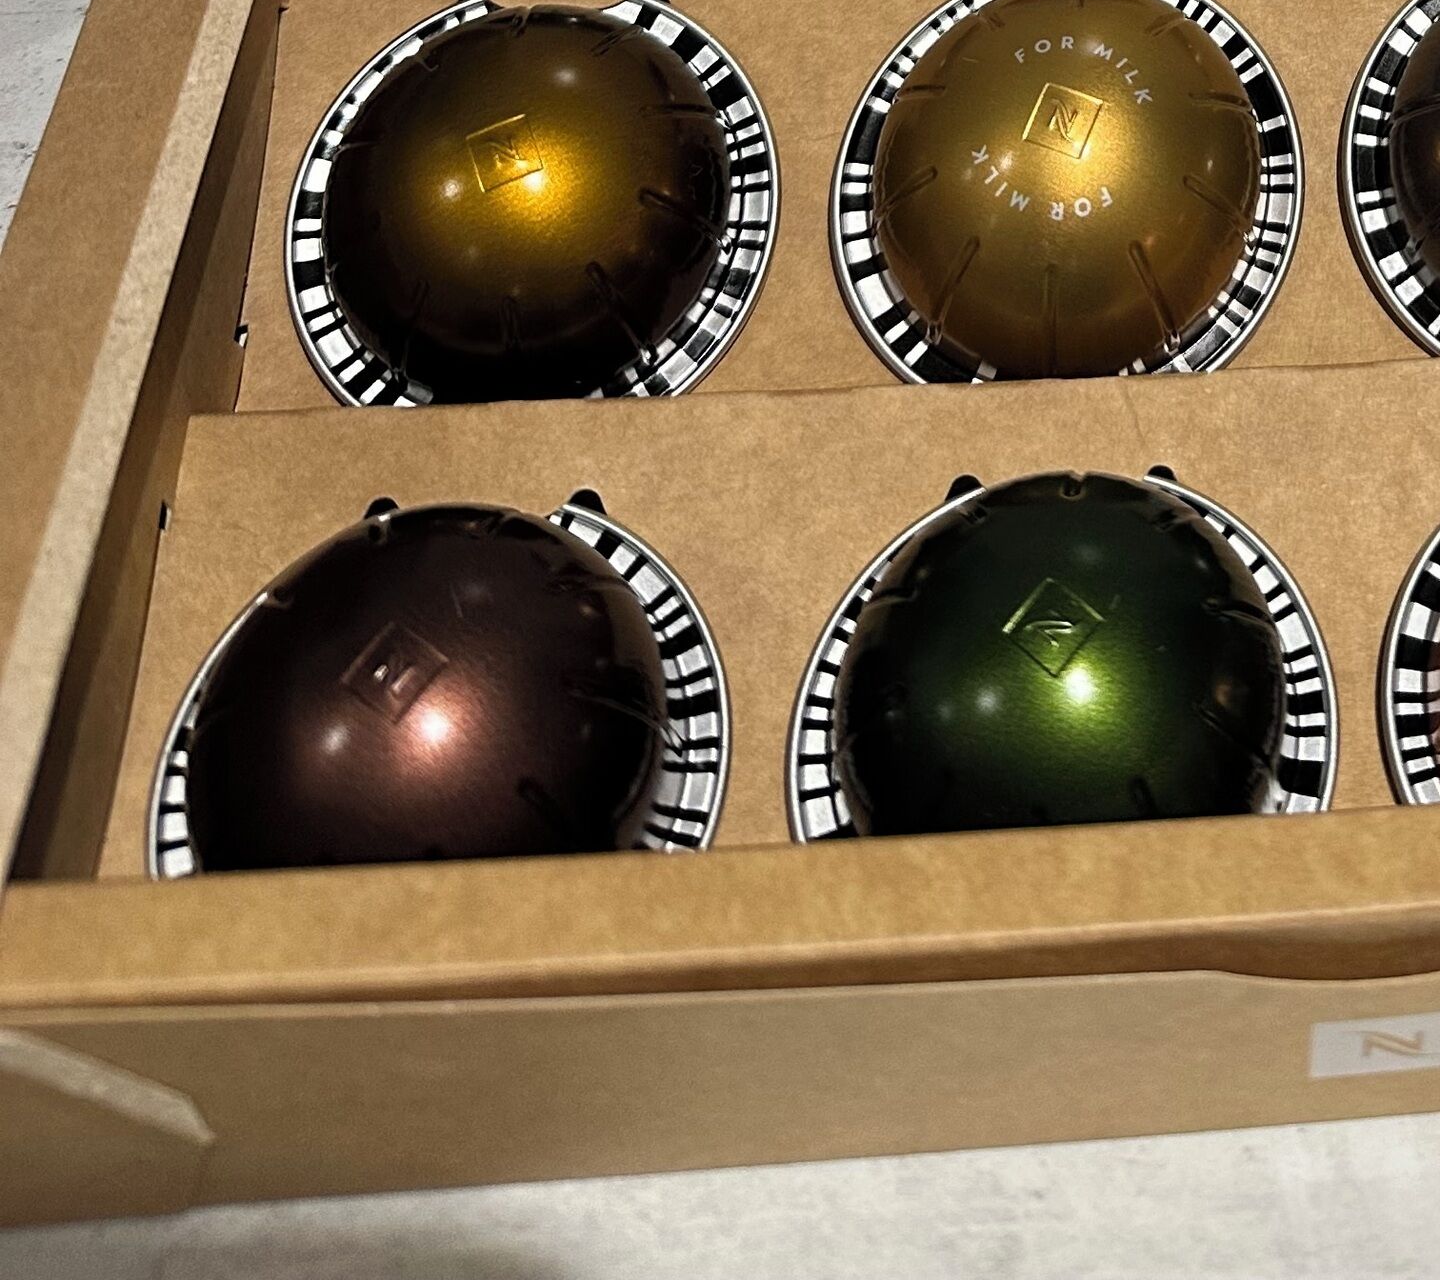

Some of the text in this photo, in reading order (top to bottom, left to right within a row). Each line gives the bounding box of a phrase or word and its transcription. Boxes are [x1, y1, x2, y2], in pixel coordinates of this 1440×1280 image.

[1015, 36, 1153, 105] FOR MILK
[972, 144, 1112, 220] FOR MILK
